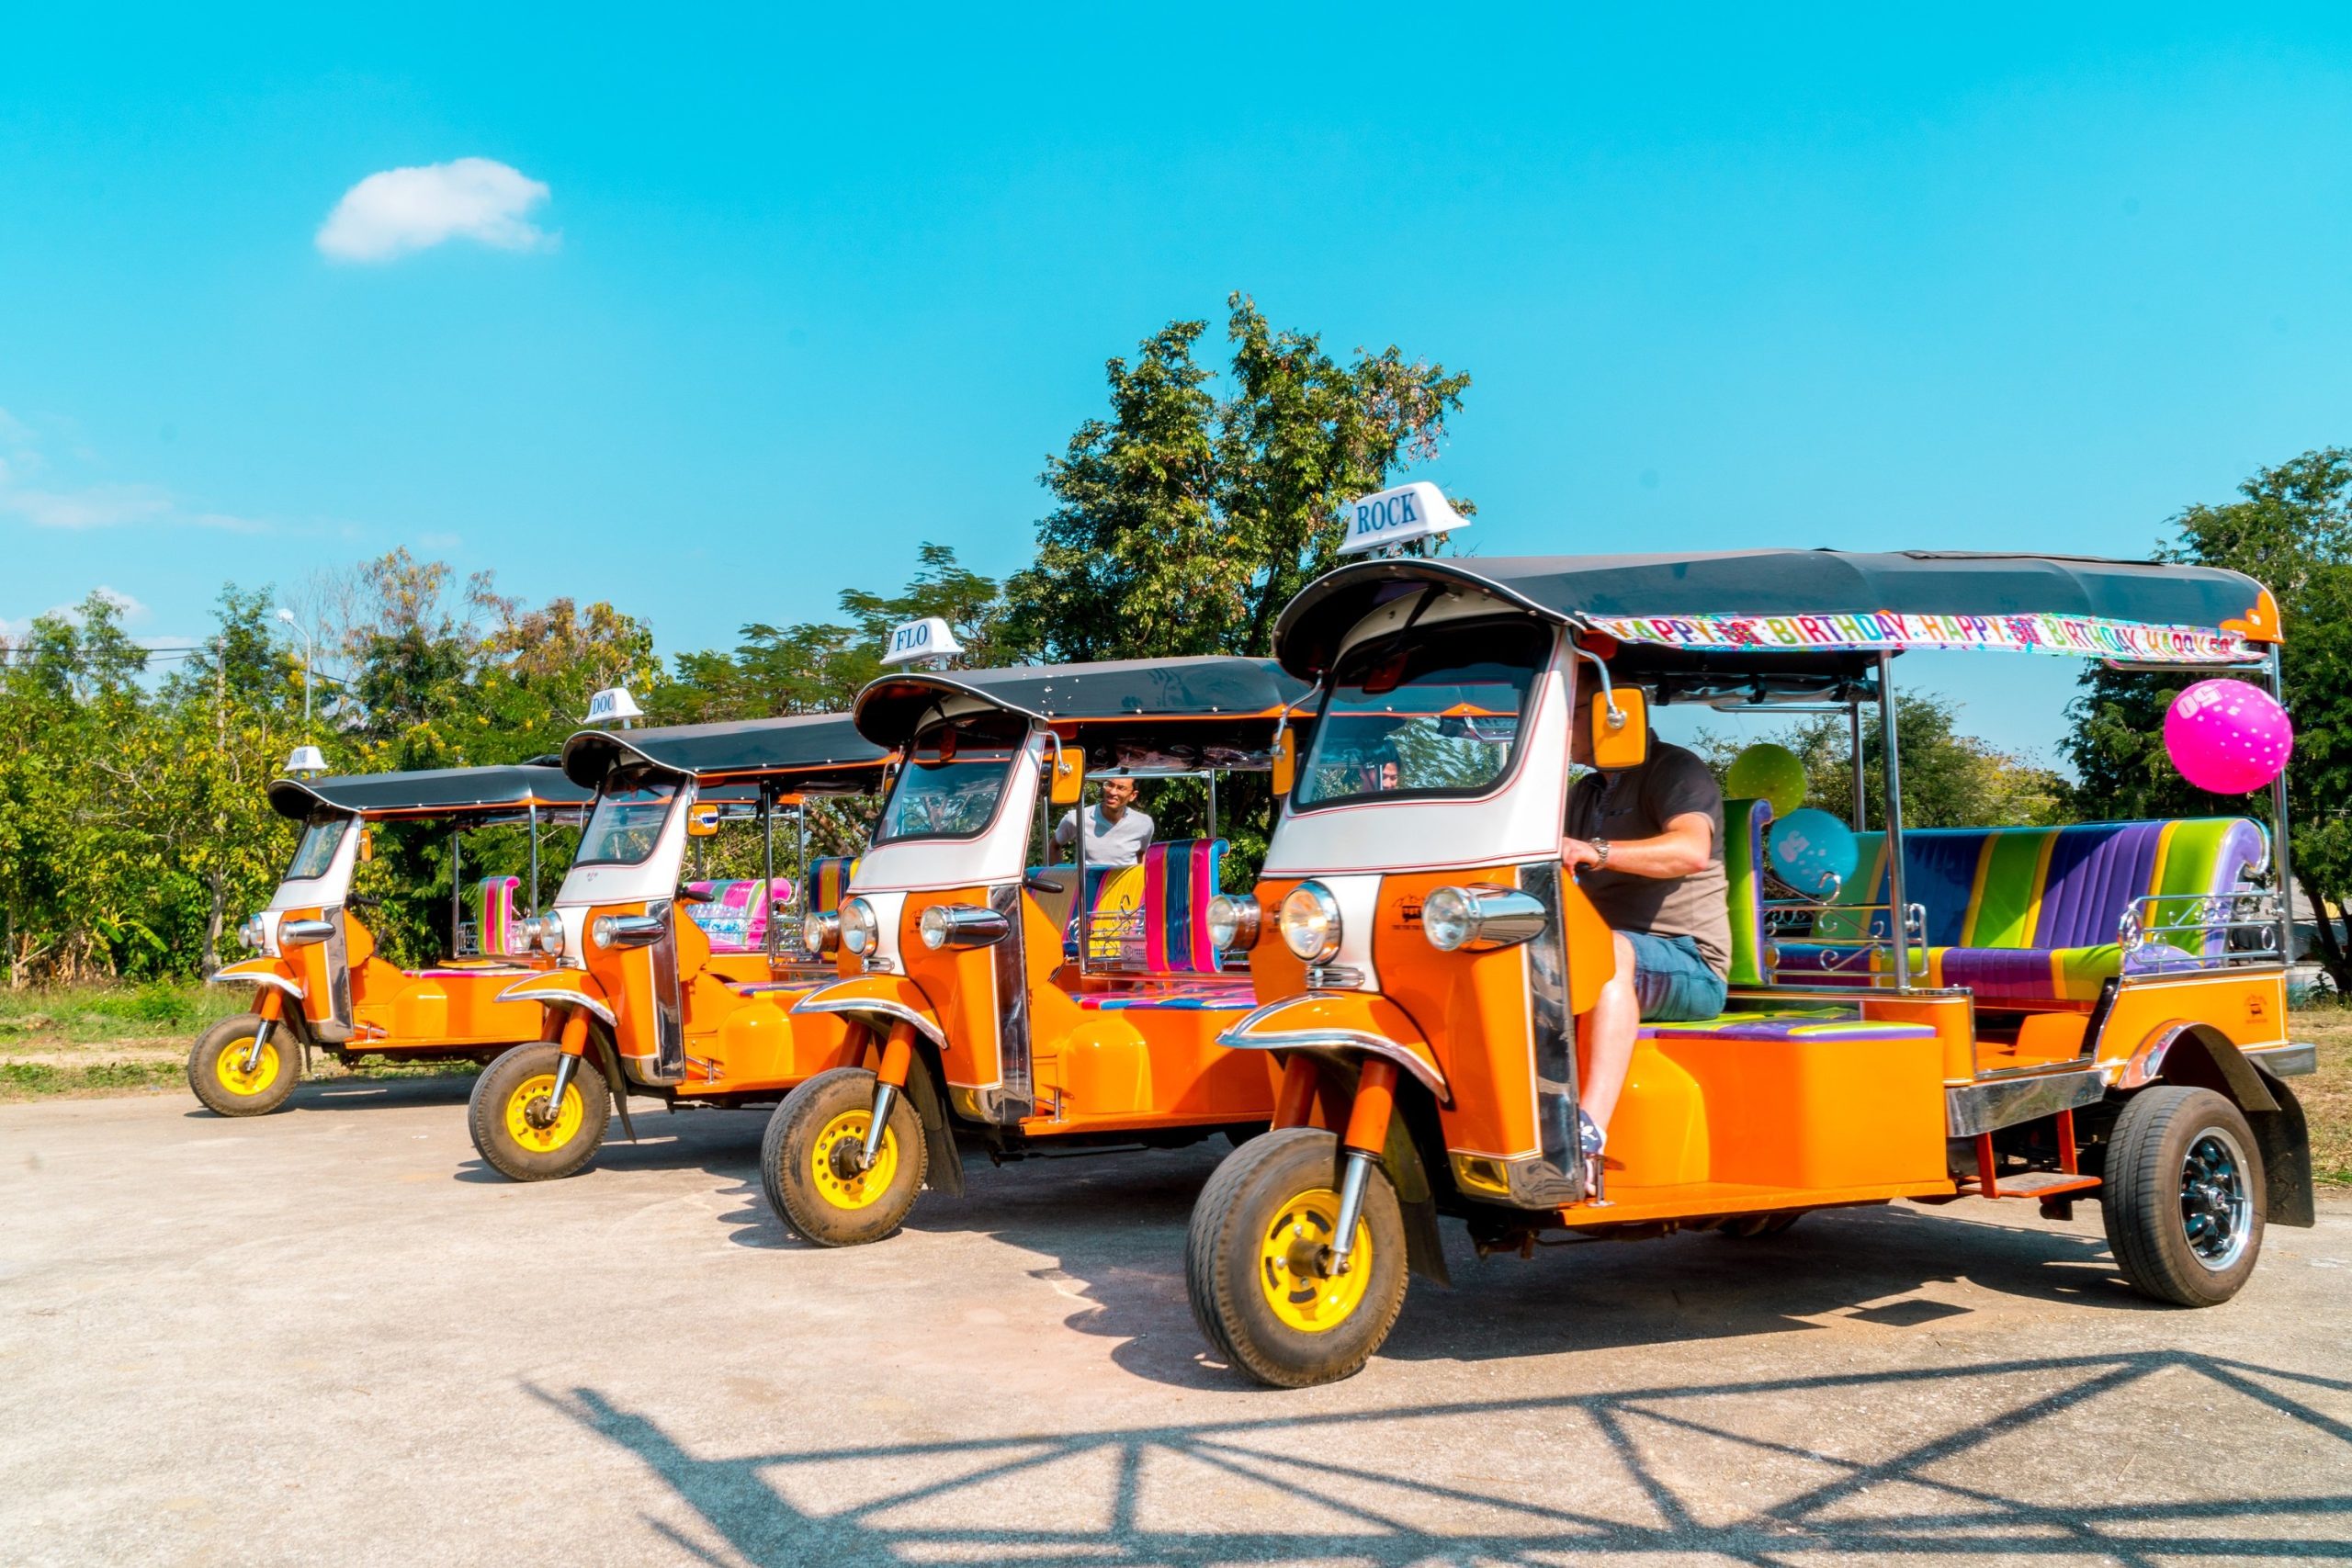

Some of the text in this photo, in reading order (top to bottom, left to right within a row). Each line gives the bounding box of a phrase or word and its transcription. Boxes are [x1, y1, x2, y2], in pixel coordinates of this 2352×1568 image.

[1356, 492, 1417, 535] ROCK
[895, 624, 928, 651] FLO
[1766, 615, 1912, 645] BIRTHDAY
[1917, 615, 2005, 642] HAPPY
[2042, 618, 2144, 655] BIRTHDAY
[2146, 631, 2211, 656] HAPPY
[592, 694, 615, 715] DOC
